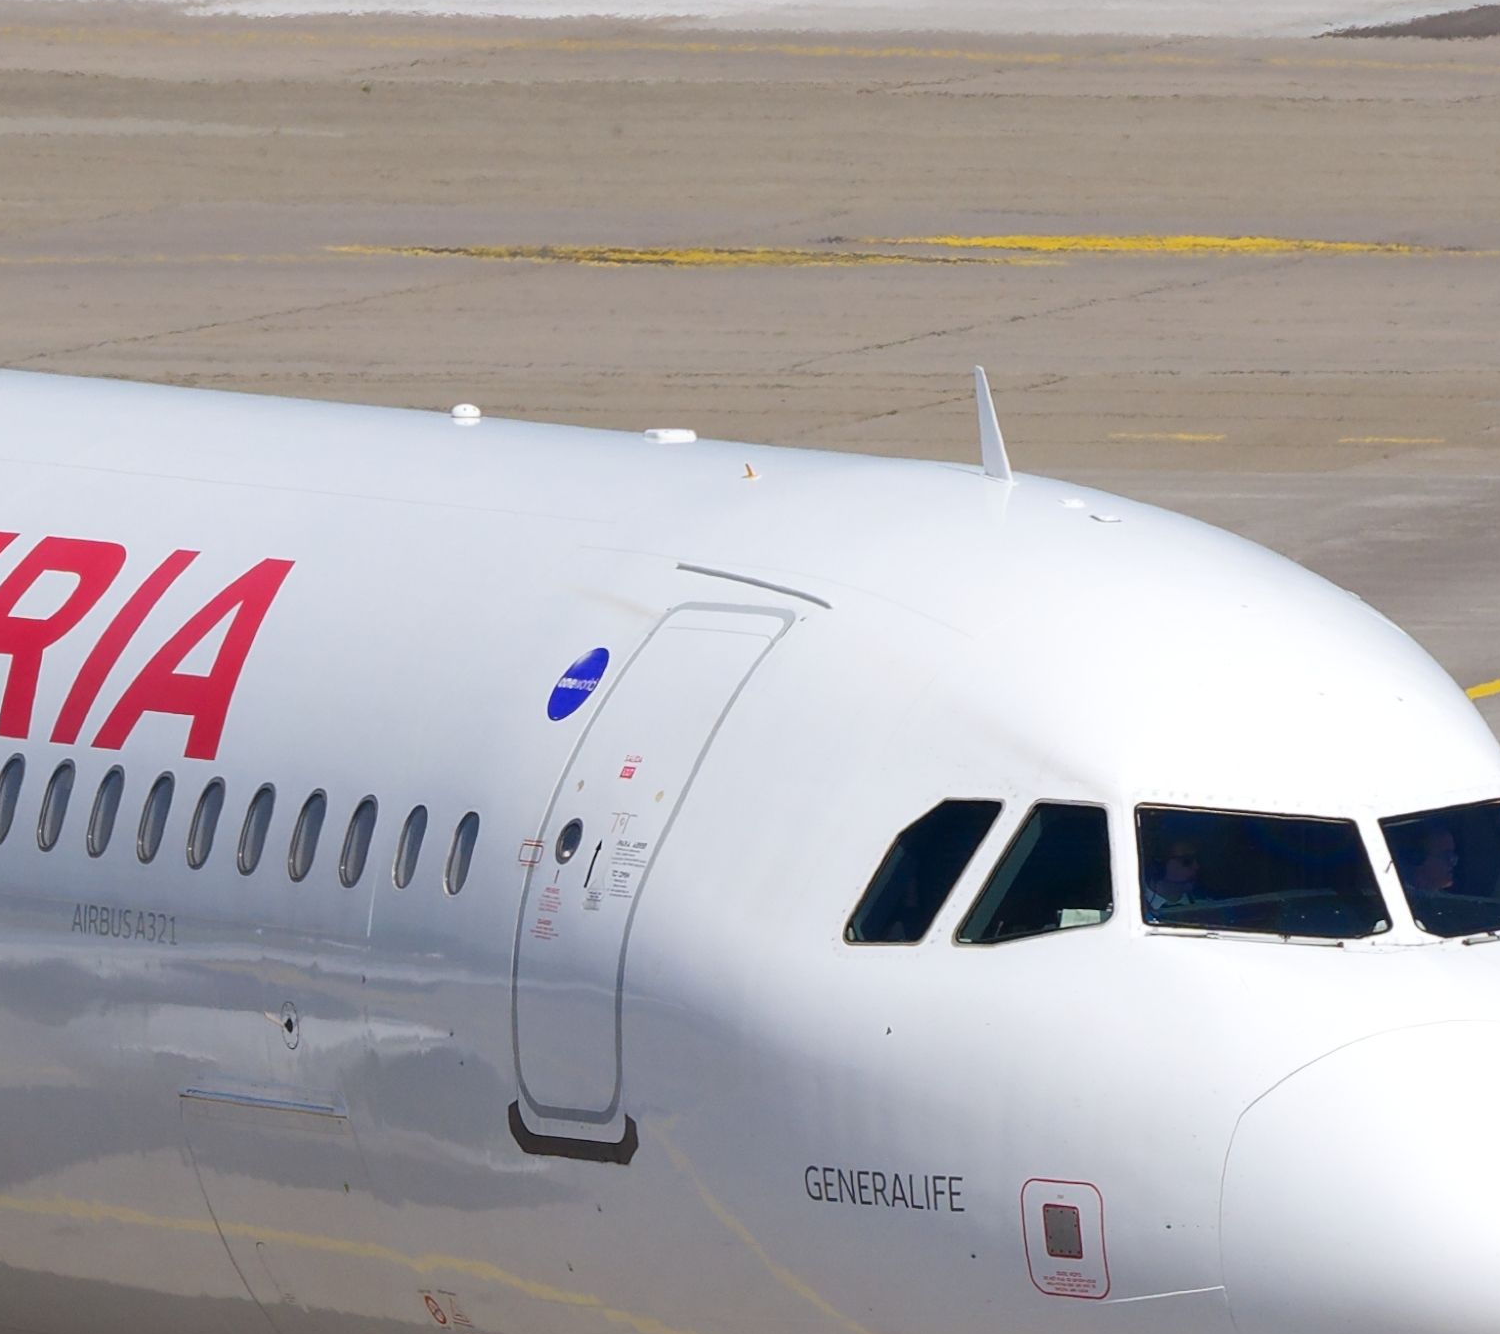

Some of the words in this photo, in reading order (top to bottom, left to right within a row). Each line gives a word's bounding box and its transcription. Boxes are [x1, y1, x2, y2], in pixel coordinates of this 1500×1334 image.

[71, 903, 132, 939] AIRBUS
[134, 911, 178, 946] A321
[804, 1165, 965, 1212] GENERALIFE
